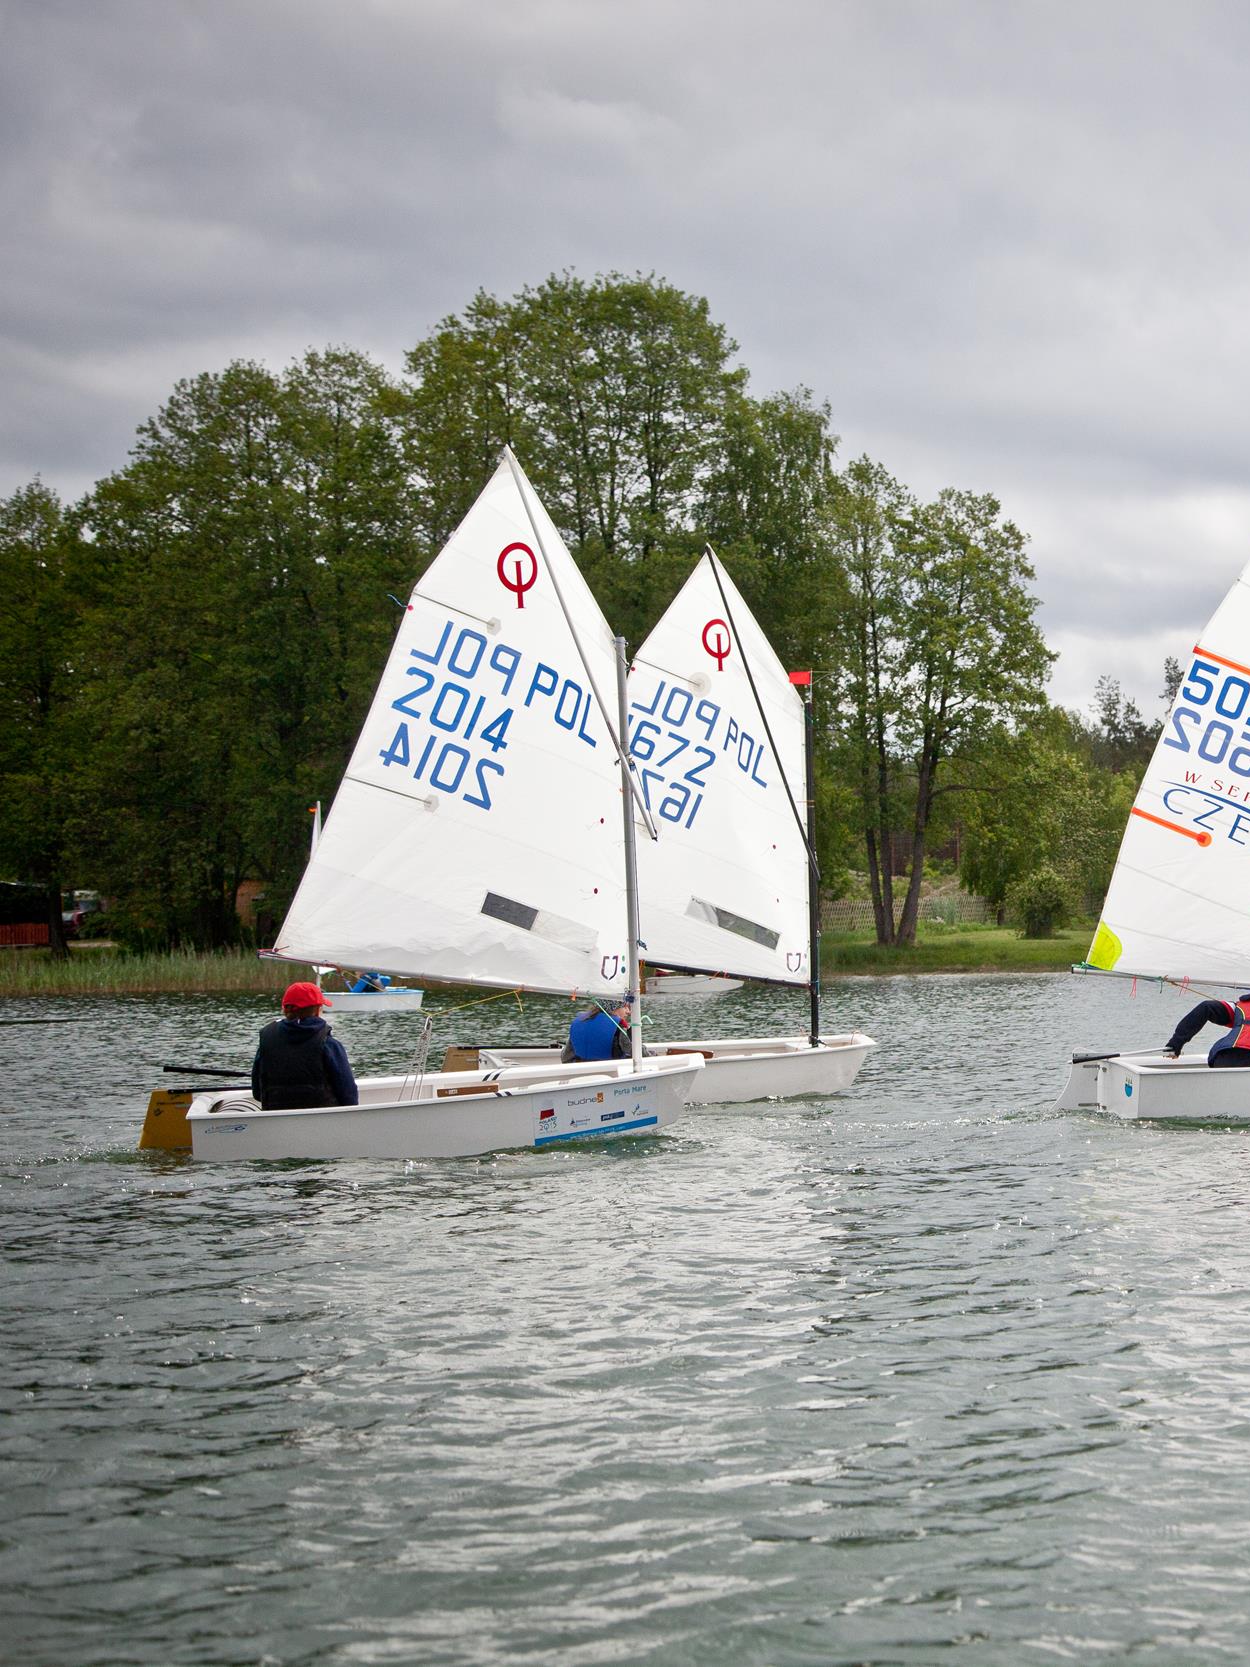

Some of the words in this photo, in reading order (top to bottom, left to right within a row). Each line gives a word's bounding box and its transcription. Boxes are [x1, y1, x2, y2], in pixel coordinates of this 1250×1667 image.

[391, 666, 514, 753] 2014
[524, 662, 597, 749] POL
[723, 716, 767, 789] POL
[1184, 770, 1202, 784] W
[614, 1087, 630, 1096] Porta
